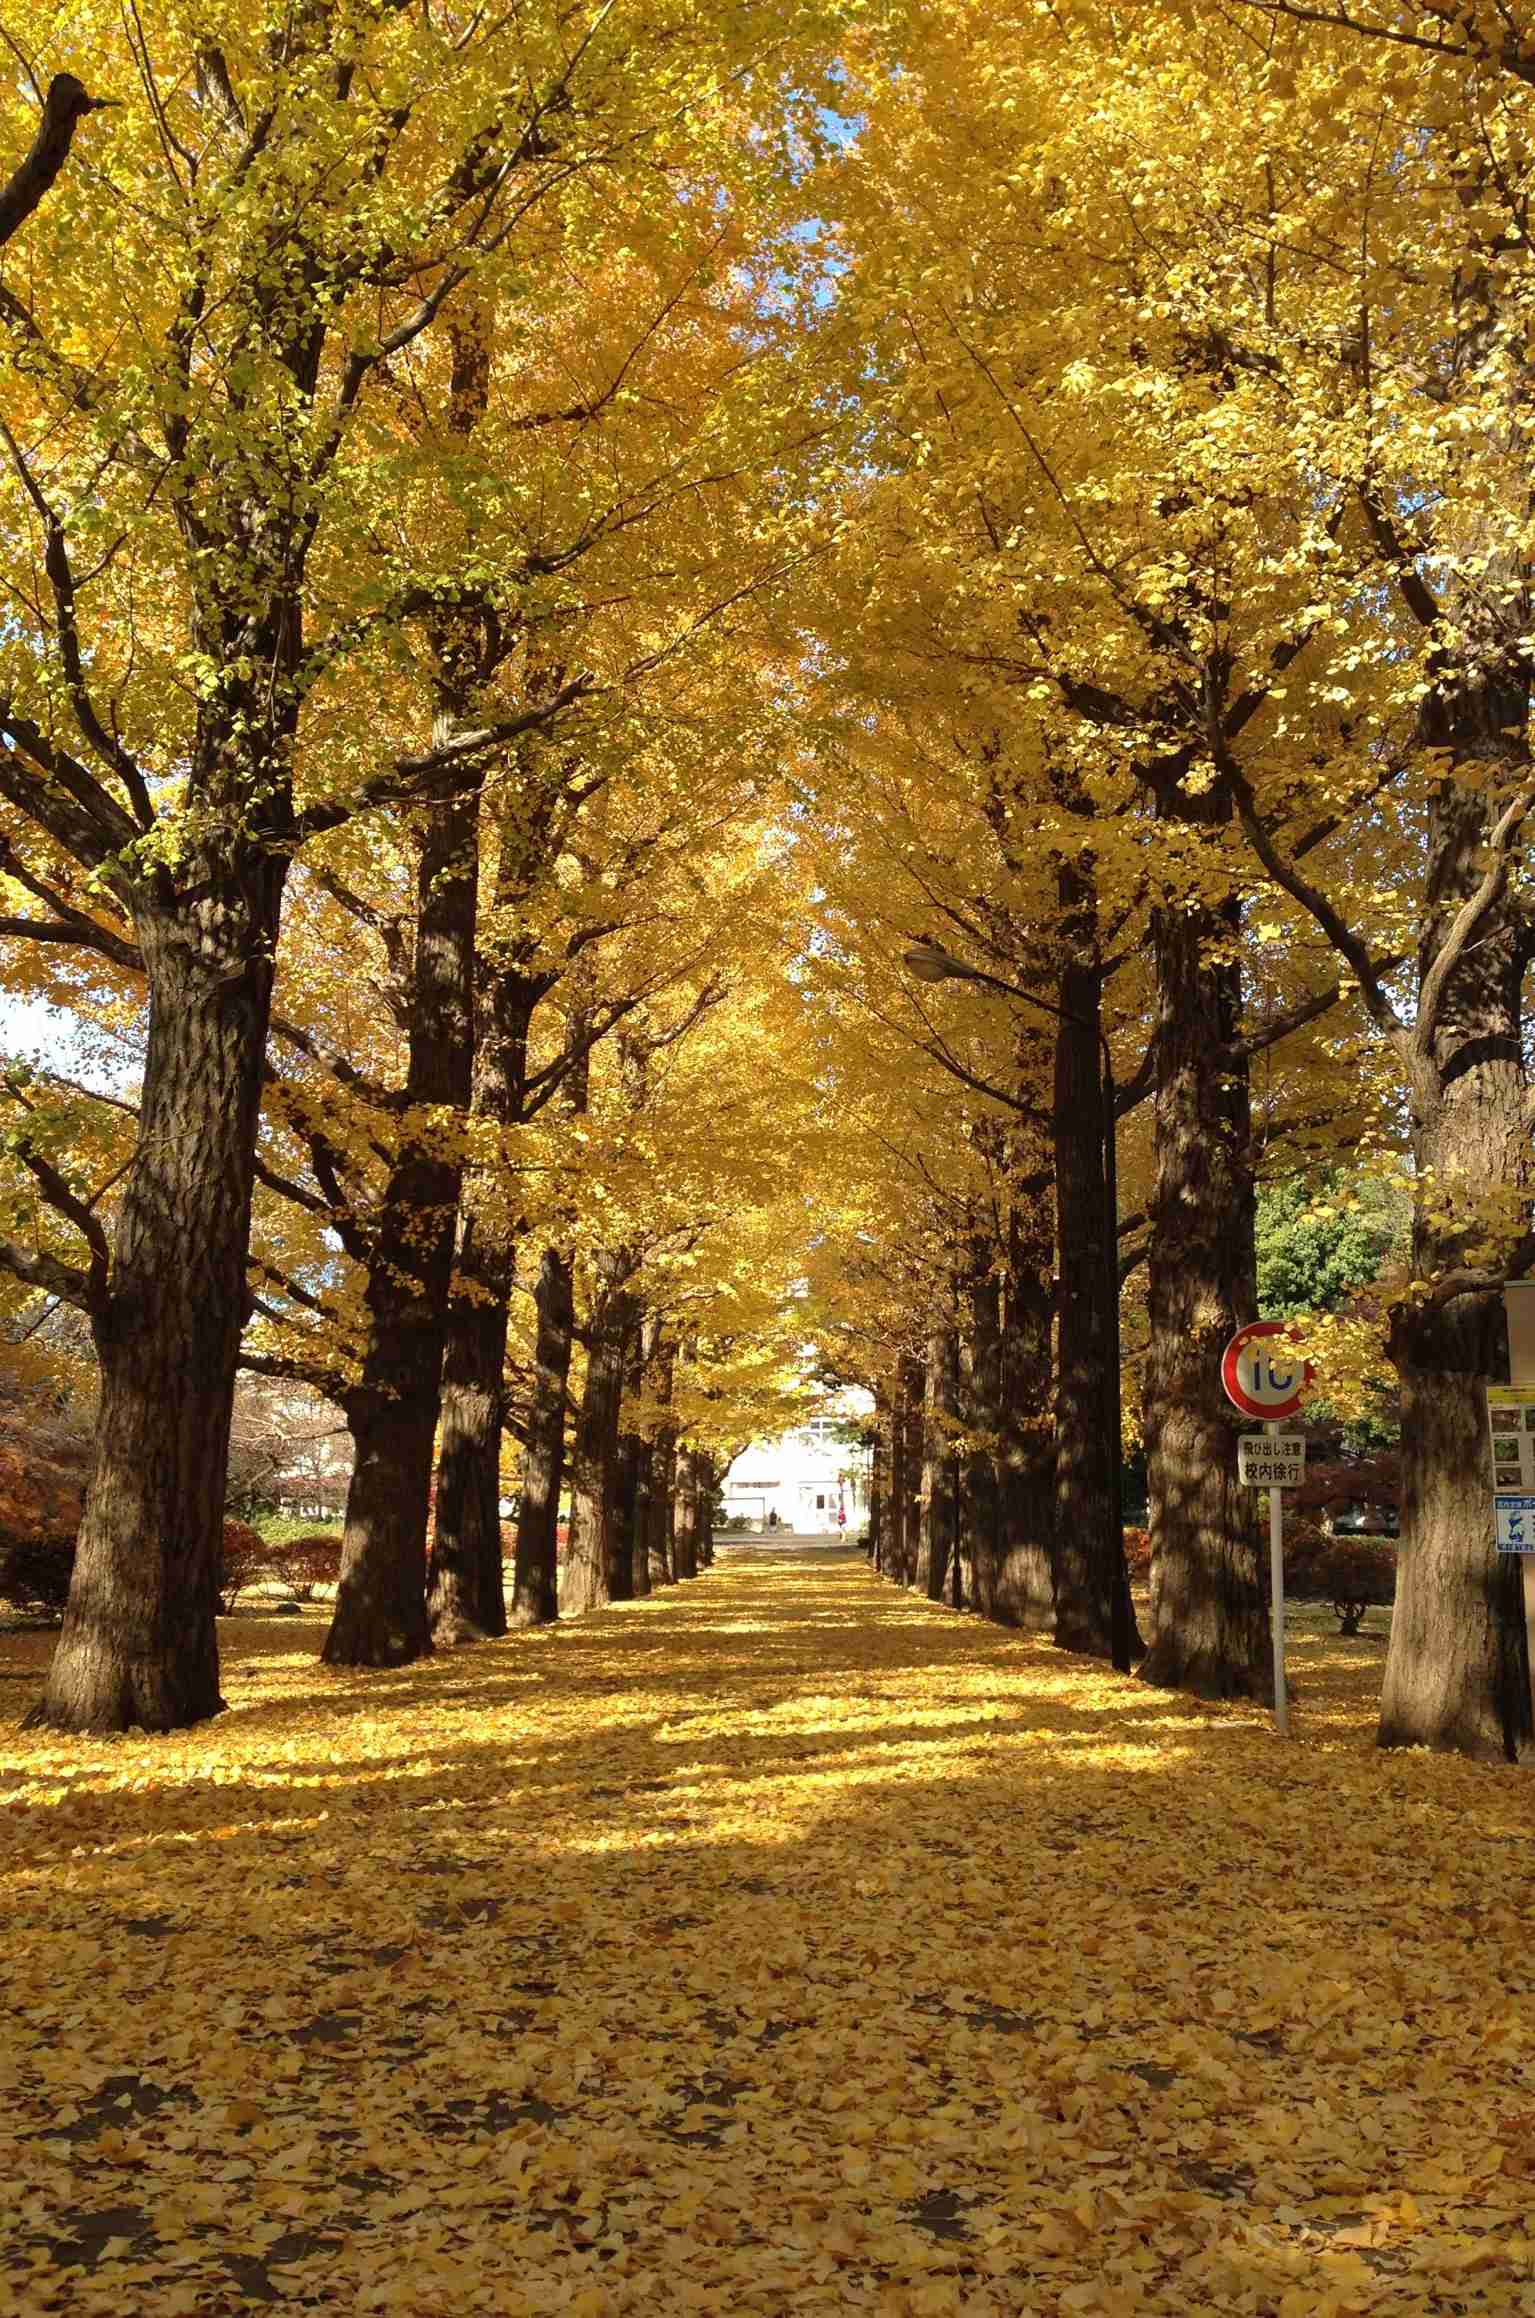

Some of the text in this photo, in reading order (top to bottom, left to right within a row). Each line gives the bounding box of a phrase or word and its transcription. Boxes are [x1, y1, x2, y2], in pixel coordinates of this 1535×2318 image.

[1244, 1441, 1301, 1456] 飛び出し注意
[1245, 1462, 1300, 1481] 校内徐行
